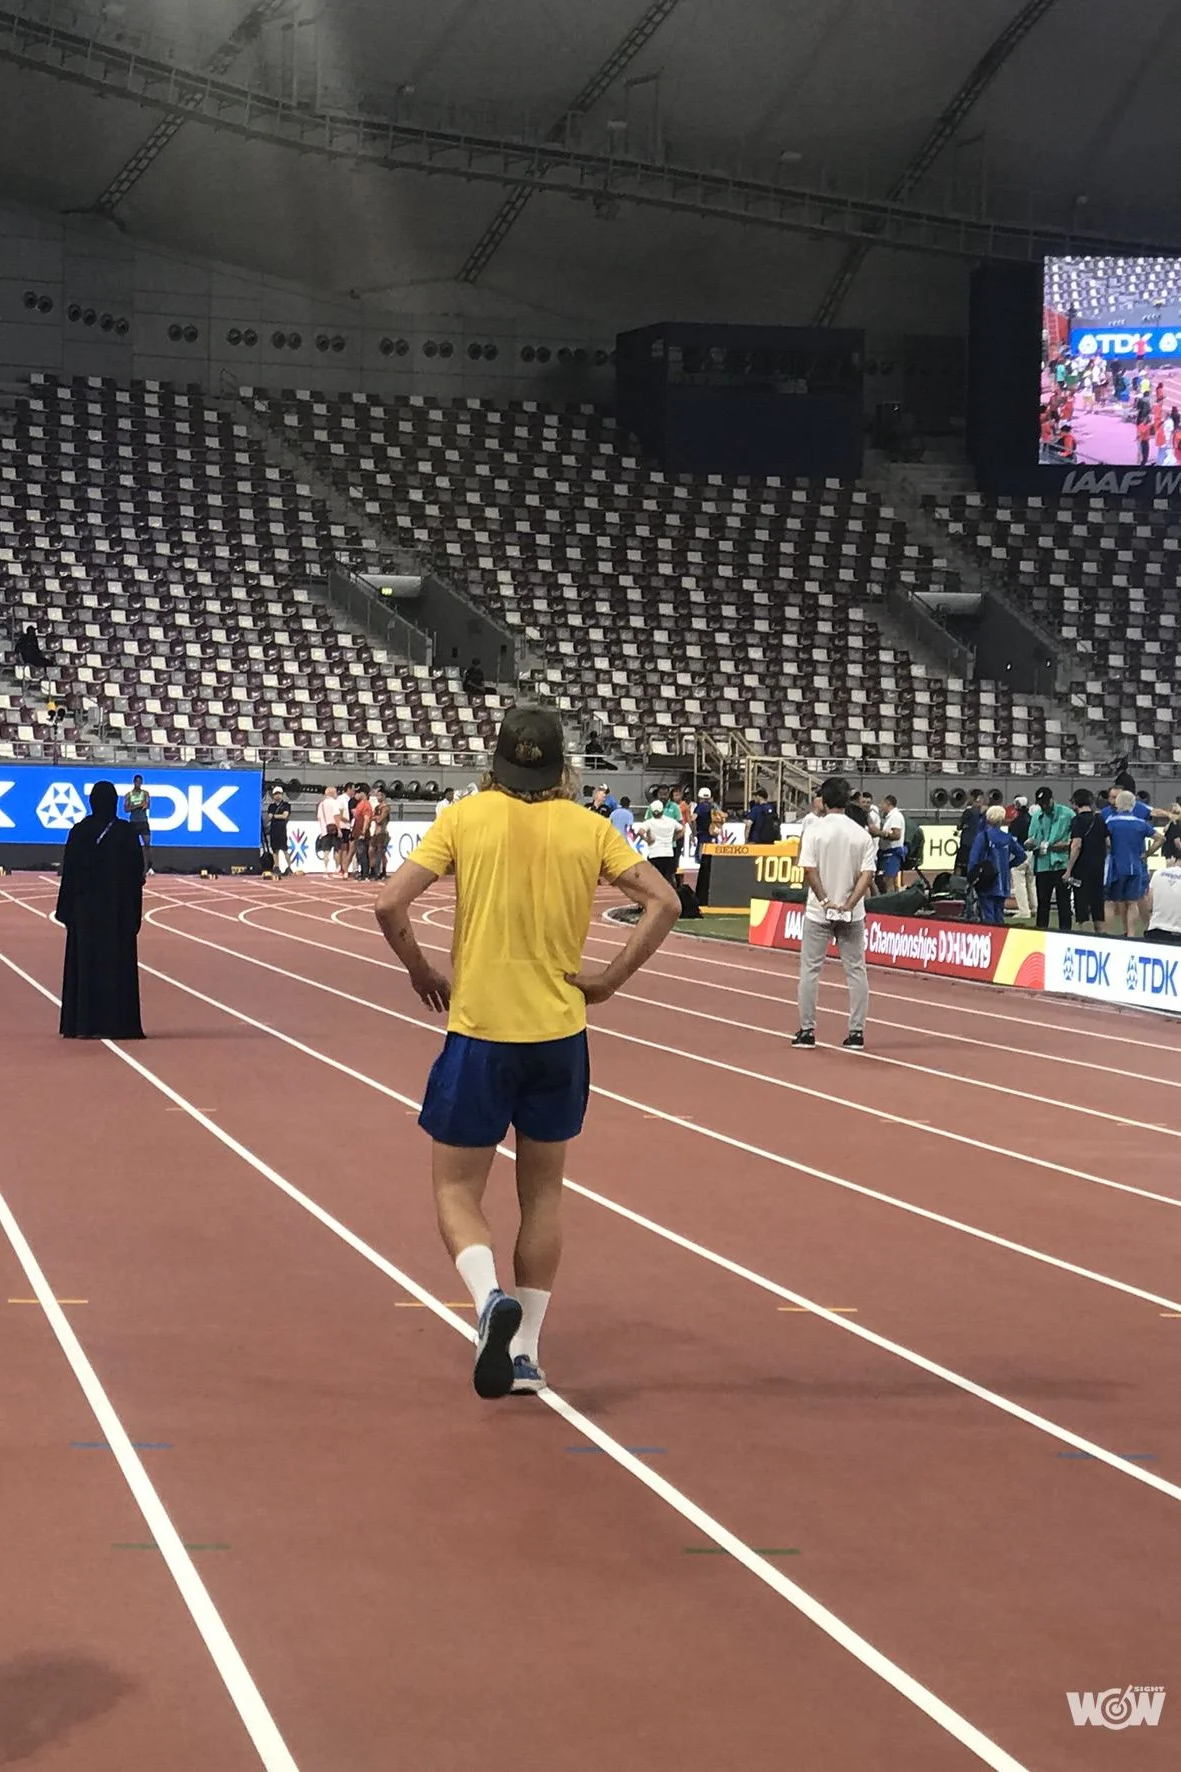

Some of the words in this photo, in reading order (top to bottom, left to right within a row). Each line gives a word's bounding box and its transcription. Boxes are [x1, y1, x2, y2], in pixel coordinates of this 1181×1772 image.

[1061, 471, 1147, 494] IAAF
[715, 845, 749, 855] SEIKO
[755, 856, 804, 883] 100m
[1074, 948, 1111, 987] TDK
[1138, 956, 1179, 997] TDK
